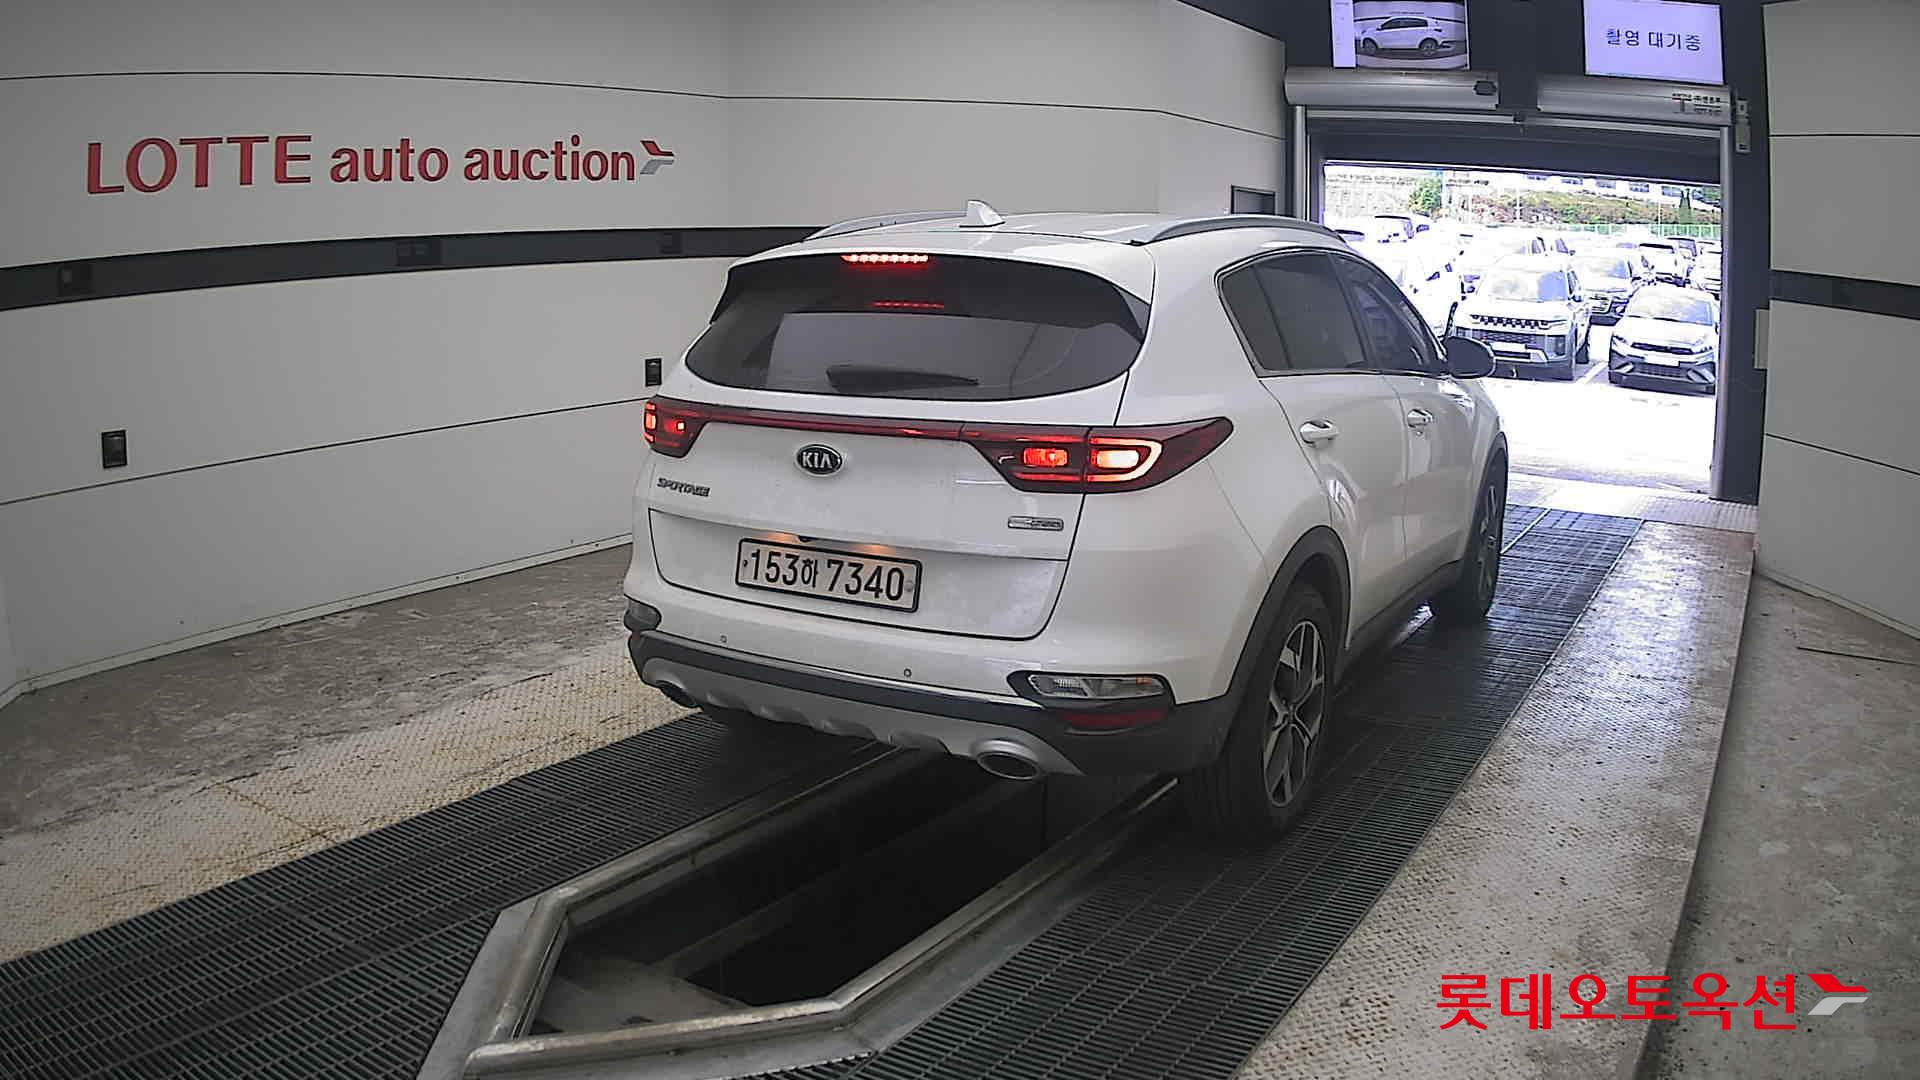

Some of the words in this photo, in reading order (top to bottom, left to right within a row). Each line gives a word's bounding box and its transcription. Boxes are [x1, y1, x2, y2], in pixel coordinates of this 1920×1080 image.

[1648, 31, 1702, 52] 대기중
[86, 135, 312, 194] LOTTE
[330, 138, 449, 183] auto
[463, 134, 637, 182] auction
[802, 451, 833, 469] KIA
[751, 548, 819, 588] 153하
[826, 558, 905, 602] 7340
